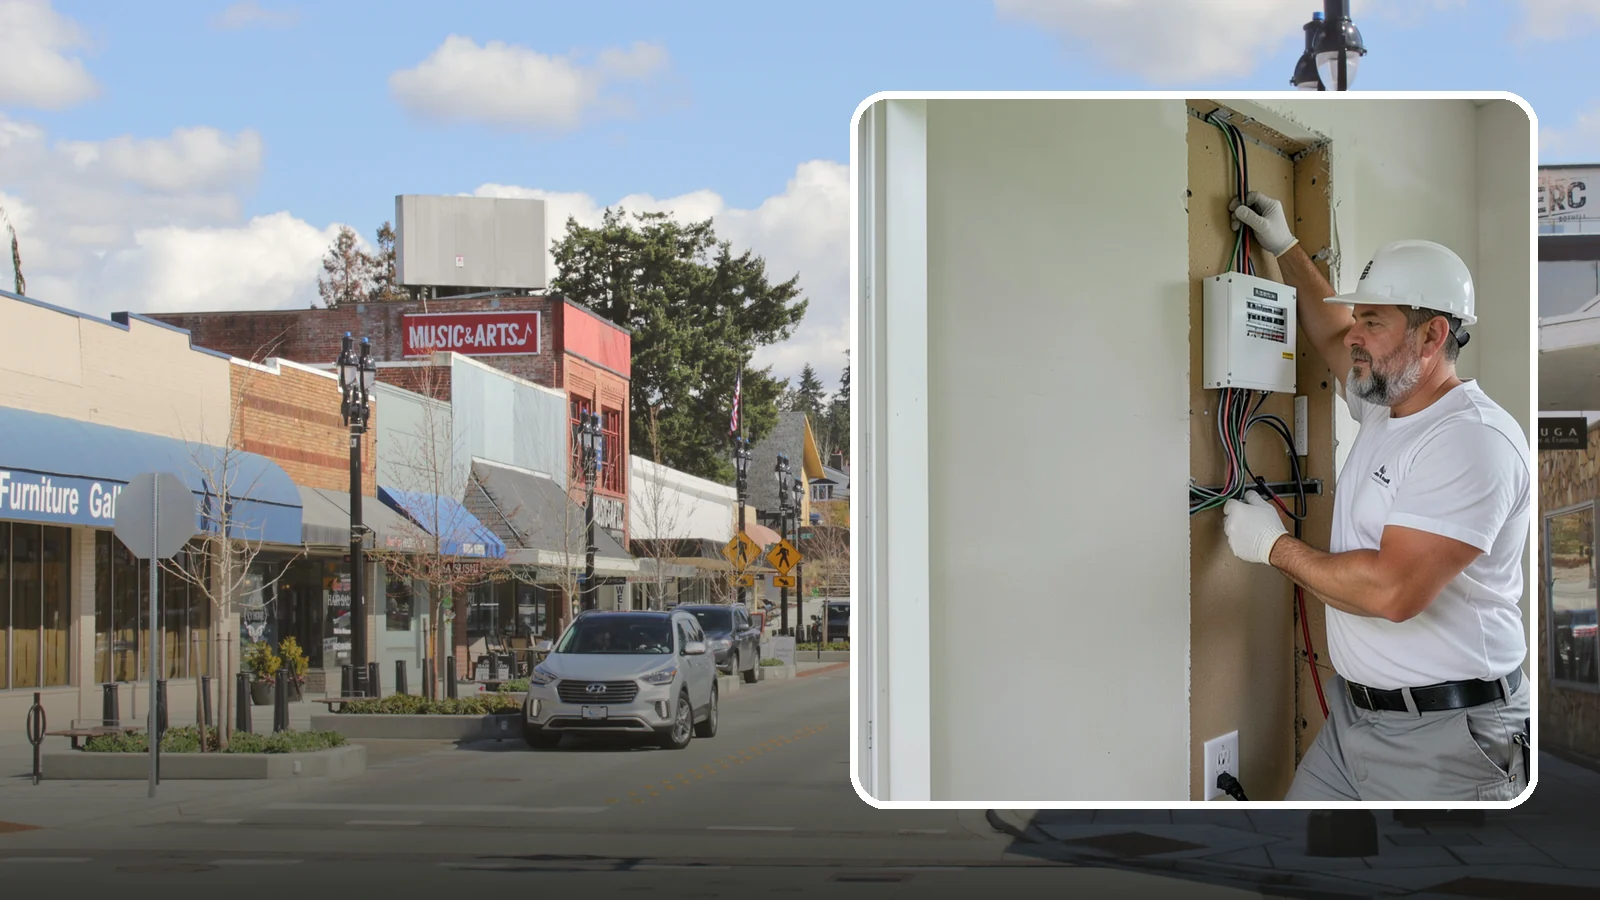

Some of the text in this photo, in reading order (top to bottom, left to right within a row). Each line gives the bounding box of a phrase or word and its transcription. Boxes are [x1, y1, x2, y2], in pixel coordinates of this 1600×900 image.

[409, 323, 520, 349] MUSIC&ARTS
[0, 471, 79, 516] Furniture
[453, 562, 480, 574] SUSHI
